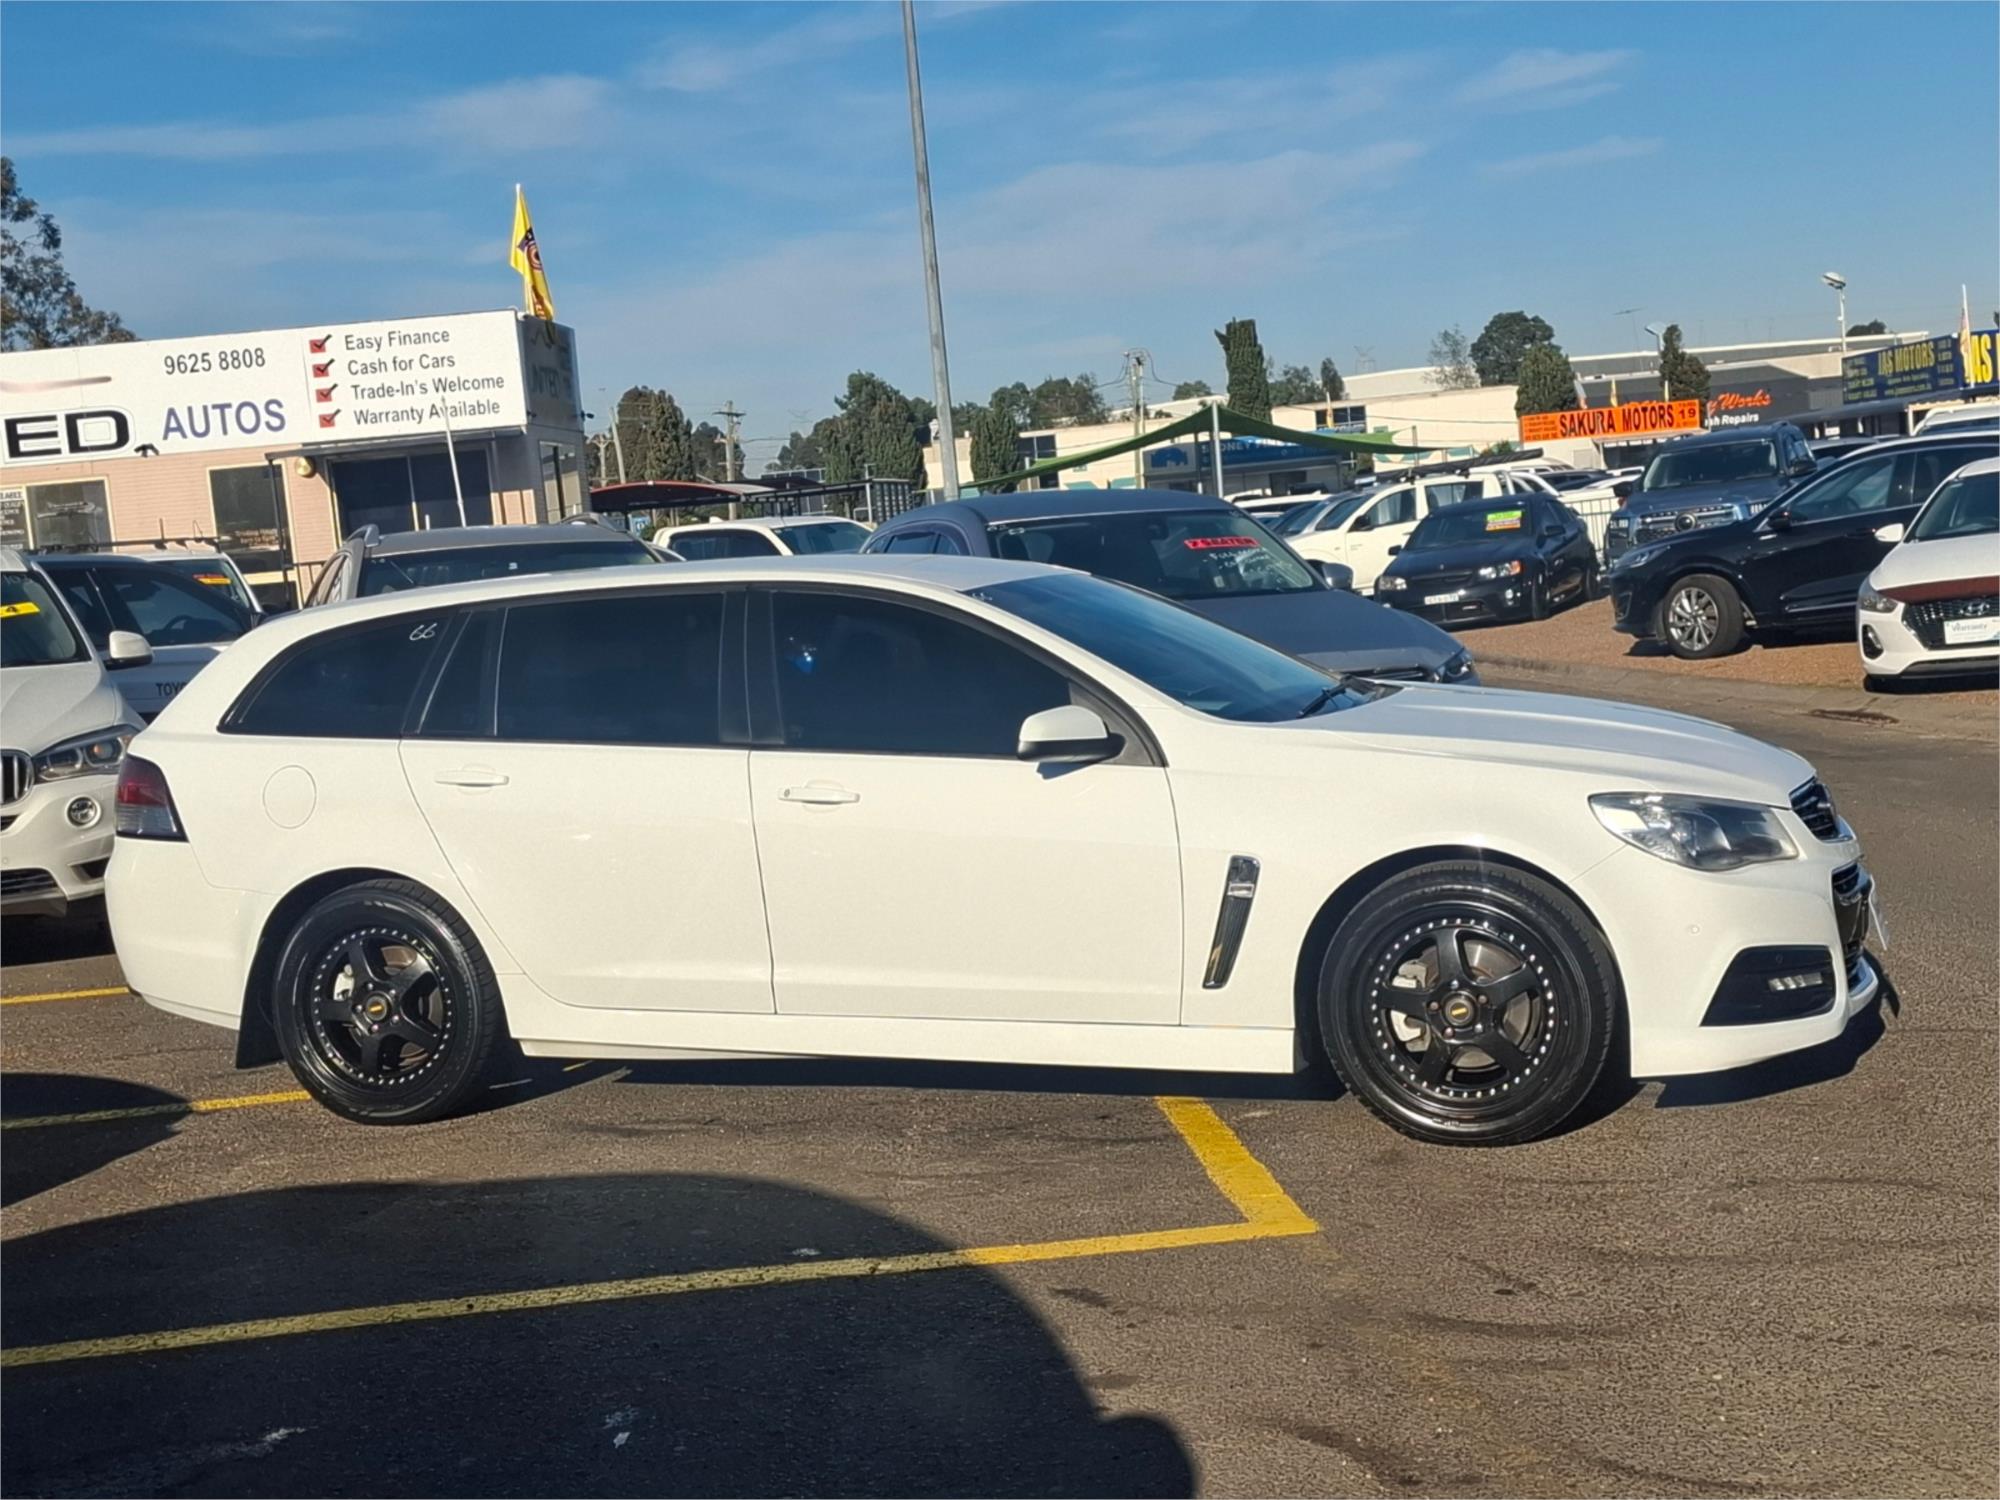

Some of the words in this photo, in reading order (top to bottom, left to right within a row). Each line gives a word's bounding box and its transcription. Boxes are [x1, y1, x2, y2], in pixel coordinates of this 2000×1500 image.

[344, 334, 383, 353] Easy
[388, 330, 450, 347] Finance
[164, 352, 212, 375] 9625
[219, 347, 266, 371] 8808
[347, 358, 388, 376] Cash
[392, 356, 415, 372] for
[419, 353, 456, 370] Cars
[351, 379, 429, 400] Trade-In's
[432, 376, 505, 394] Welcome
[162, 398, 287, 441] AUTOS
[354, 405, 425, 425] Warranty
[1559, 409, 1616, 438] SAKURA
[1622, 404, 1675, 433] MOTORS
[1721, 412, 1760, 426] Repairs
[409, 622, 437, 641] 66
